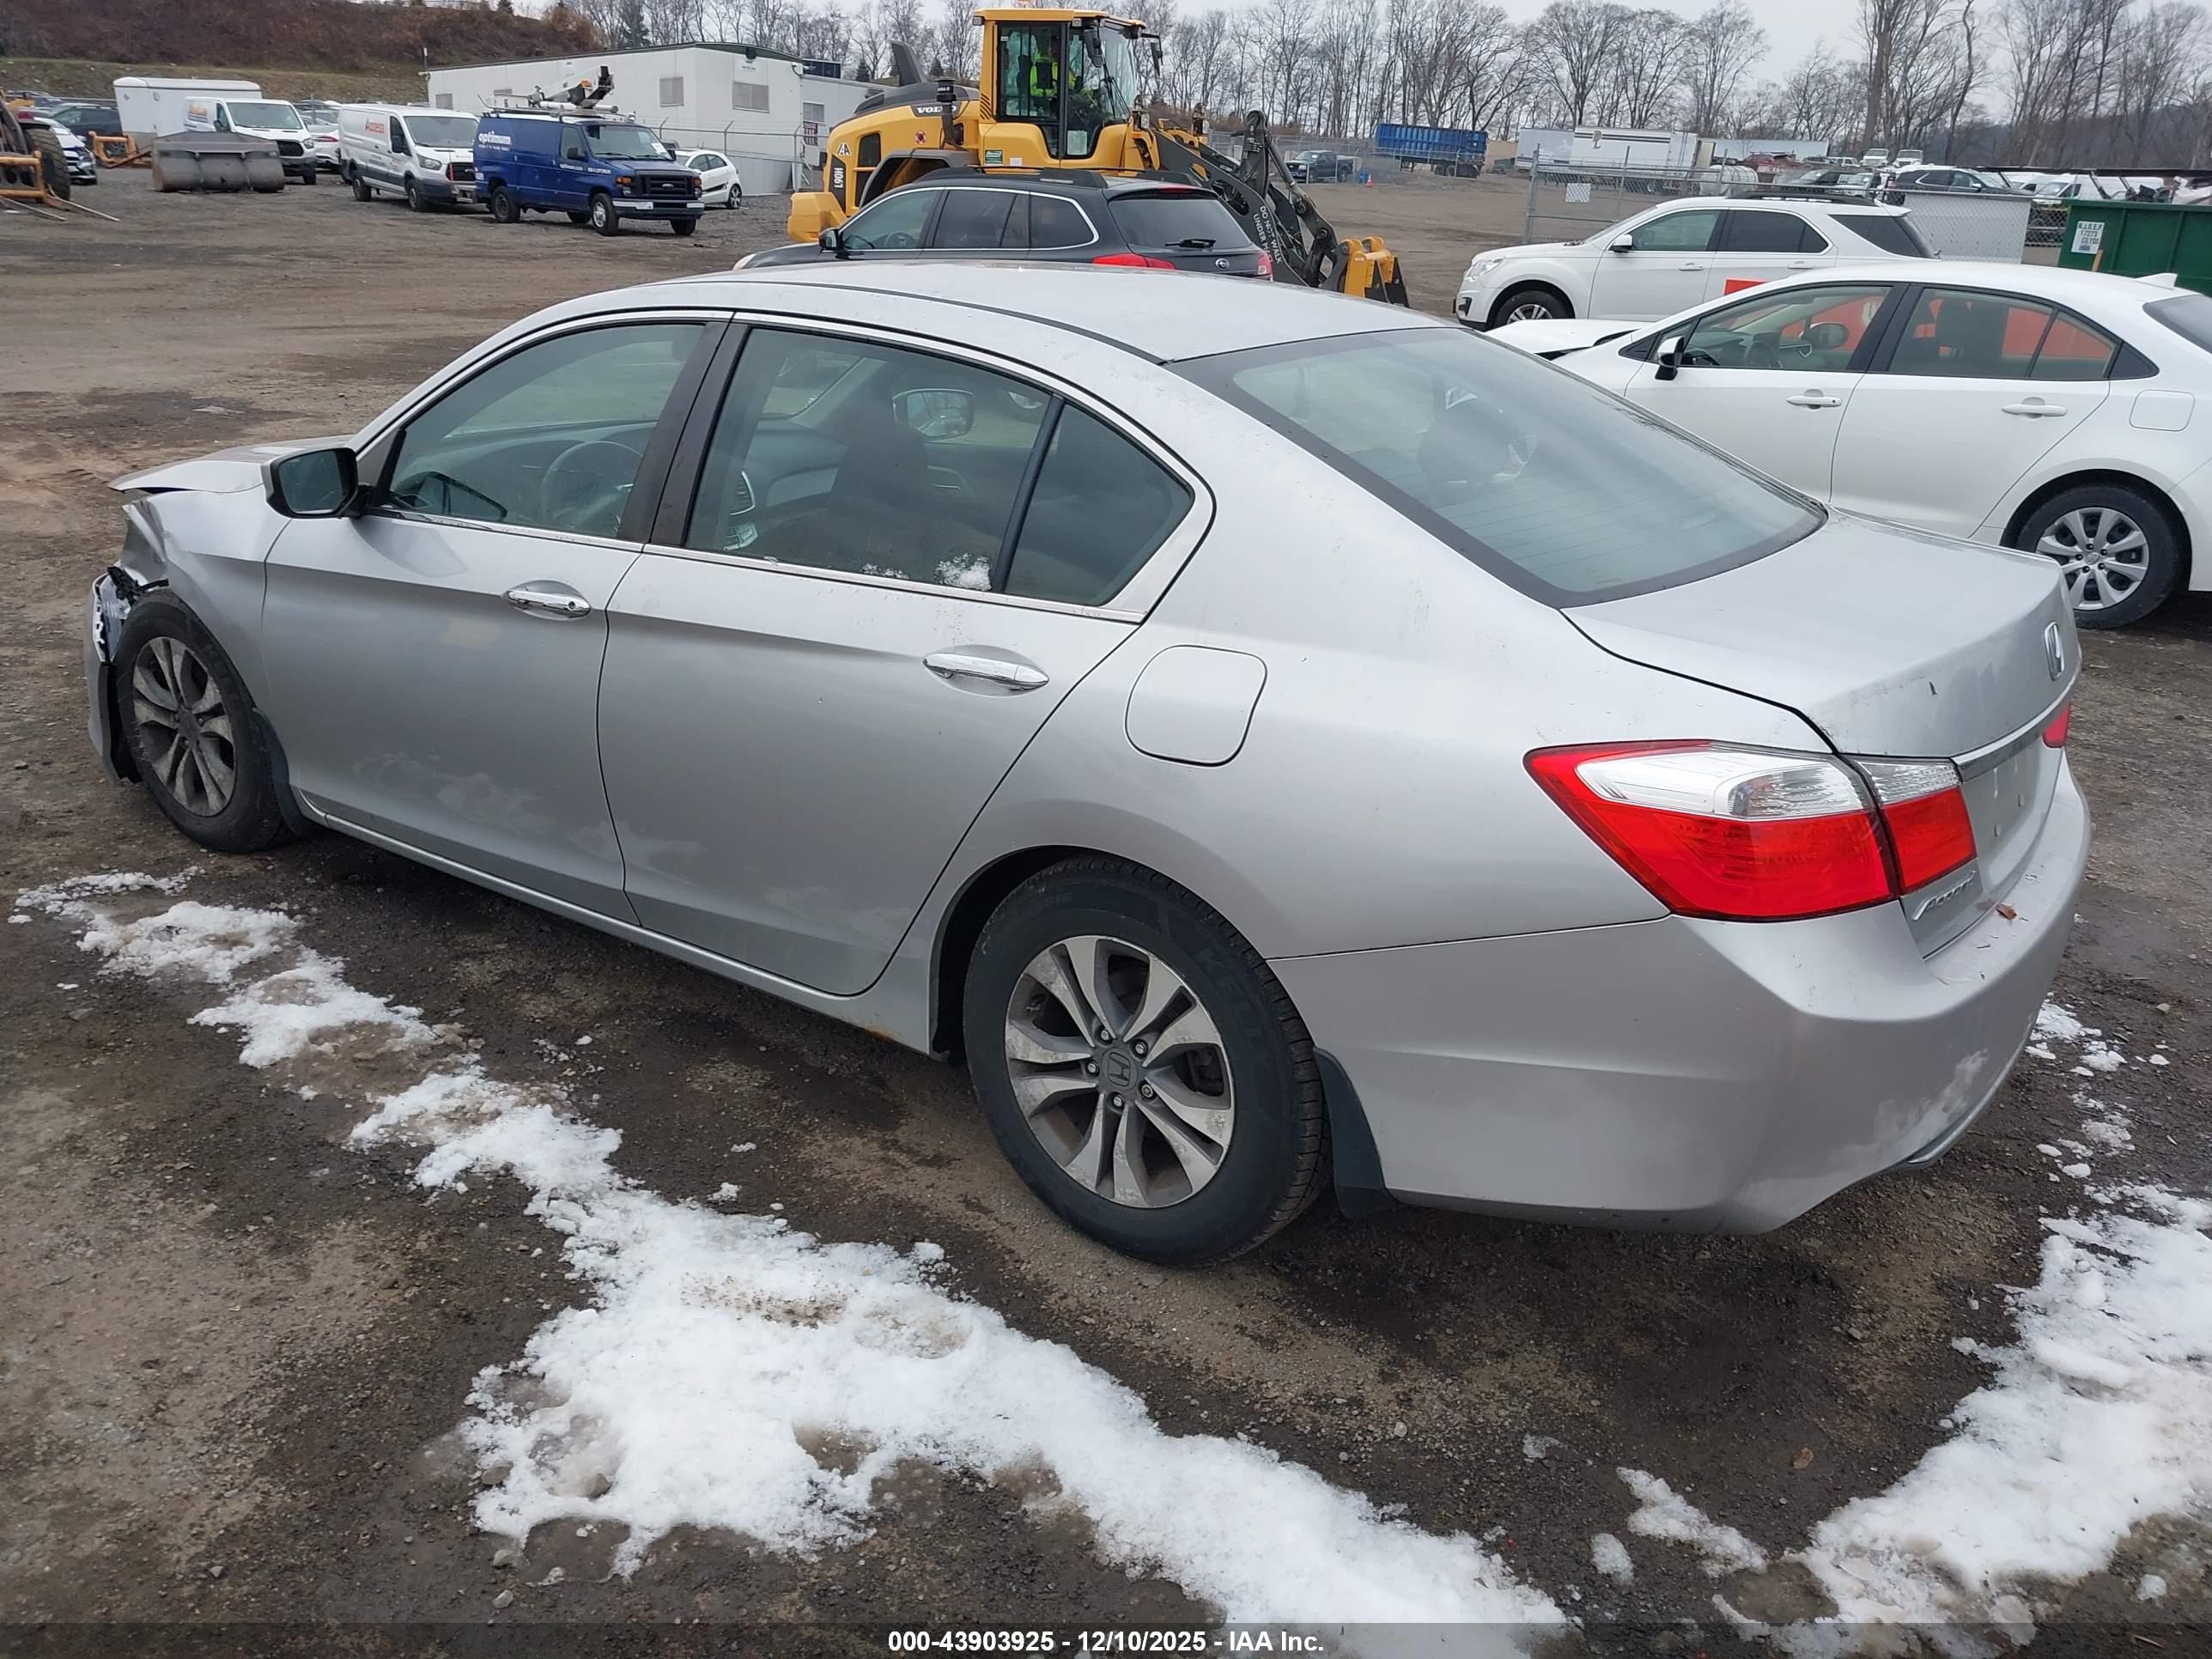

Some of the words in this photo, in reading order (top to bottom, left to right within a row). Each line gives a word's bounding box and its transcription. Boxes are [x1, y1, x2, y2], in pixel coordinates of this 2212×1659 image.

[833, 167, 844, 188] L90H
[1254, 213, 1267, 242] UNDER
[1260, 205, 1268, 219] DO
[1271, 239, 1283, 264] WALK
